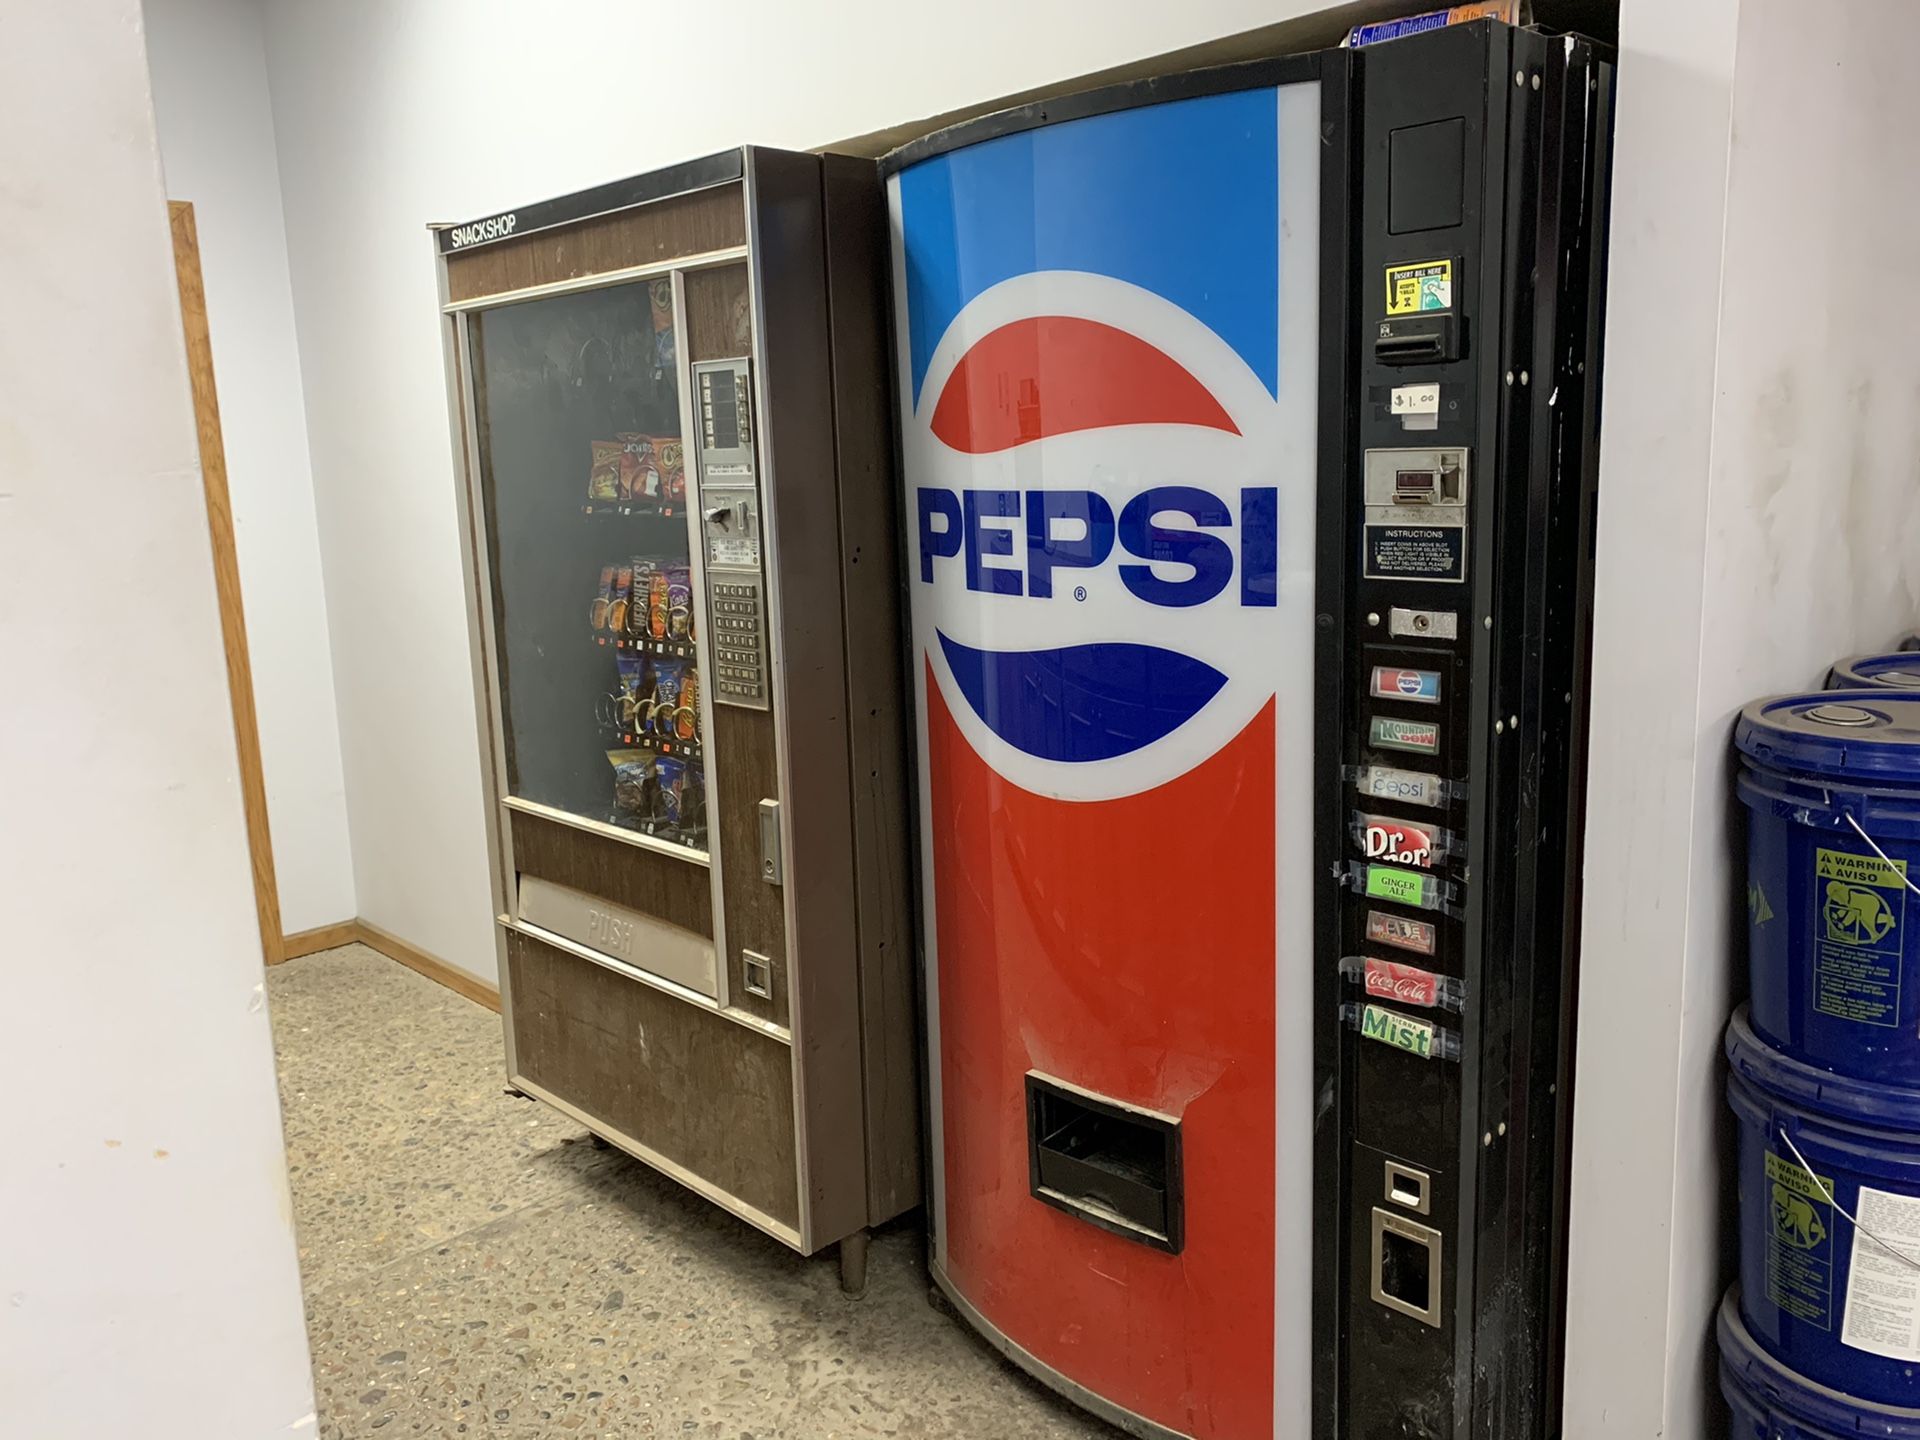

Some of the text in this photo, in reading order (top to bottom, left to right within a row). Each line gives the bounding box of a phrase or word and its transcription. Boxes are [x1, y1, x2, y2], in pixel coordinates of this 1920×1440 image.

[451, 213, 516, 248] SNACKSHOP
[1394, 266, 1442, 280] INSERT BILL HERE
[1385, 529, 1444, 539] INSTRUCTIONS
[917, 485, 1278, 608] PEPSI
[1399, 678, 1421, 686] PEPSI
[1382, 721, 1434, 739] MOUNTAIN
[1400, 734, 1434, 745] DEW
[1373, 779, 1424, 797] pepsi
[1366, 826, 1404, 857] Dr
[1381, 876, 1416, 891] GINGER
[1836, 868, 1878, 883] AVISO
[1389, 886, 1407, 897] ALE
[588, 909, 633, 955] PUSH
[1363, 1007, 1429, 1056] Mist
[1391, 1016, 1417, 1030] SIERRA
[1777, 1161, 1831, 1190] WARNIG
[1778, 1173, 1810, 1193] AVISO
